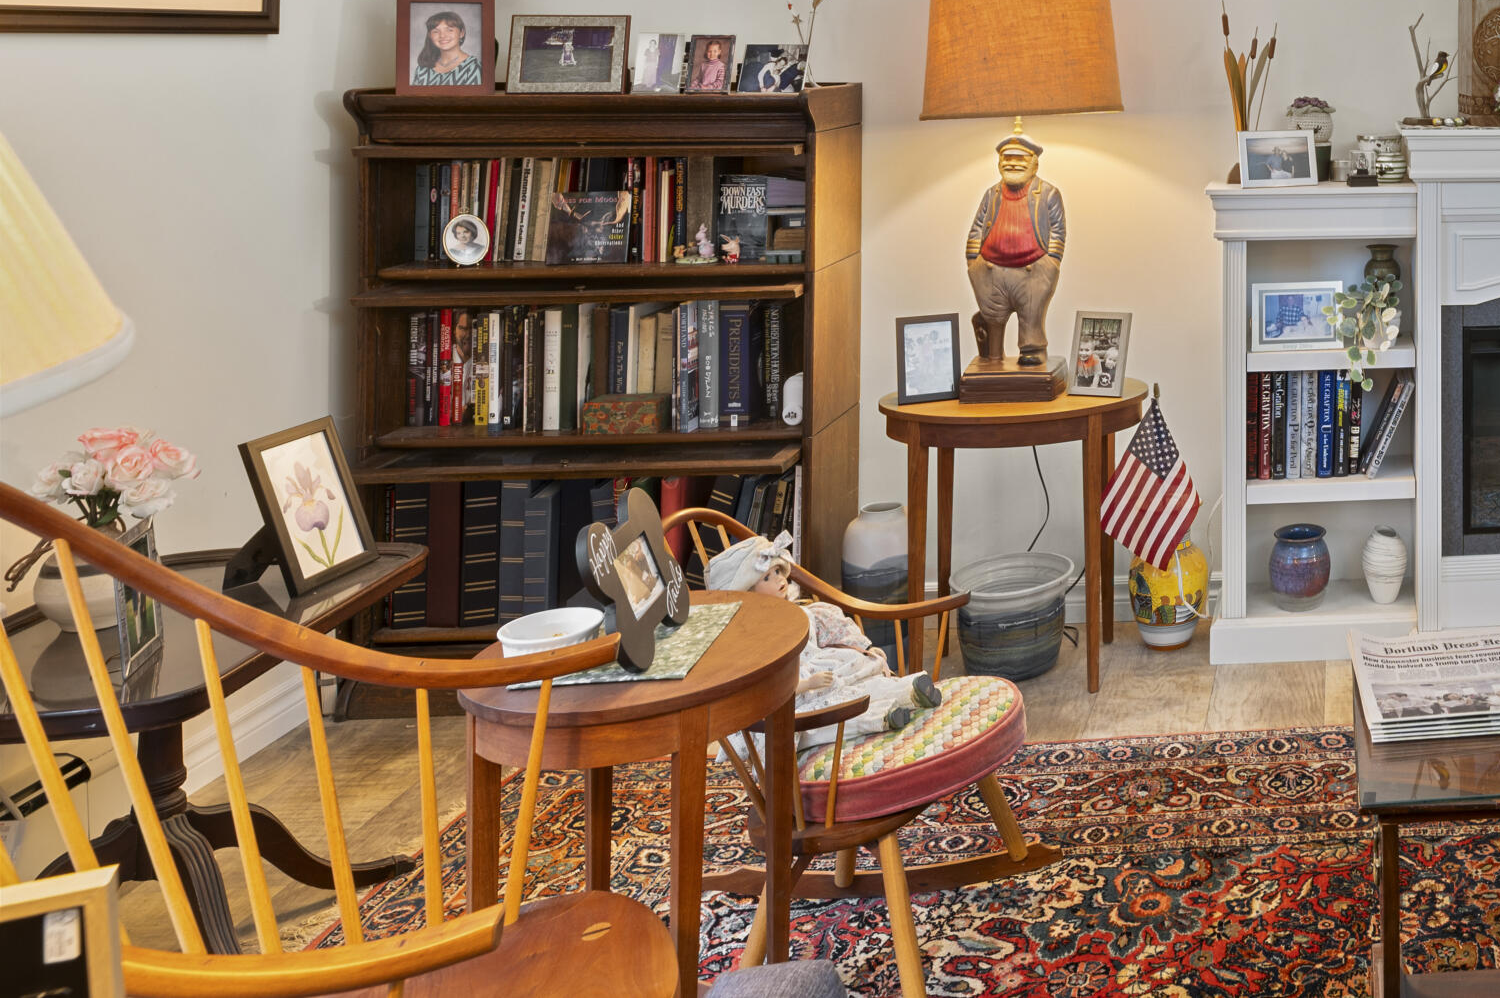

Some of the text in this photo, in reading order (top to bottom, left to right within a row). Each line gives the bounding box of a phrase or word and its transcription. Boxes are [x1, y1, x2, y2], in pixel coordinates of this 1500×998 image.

[521, 168, 531, 202] Hammer
[720, 186, 766, 197] DOWN EAST
[720, 196, 766, 214] MURDERS
[770, 308, 780, 383] NO DIRECTION HOME
[728, 318, 743, 400] PRESIDENTS
[454, 365, 462, 383] Idiot
[704, 355, 712, 398] BOB DYLAN
[1262, 373, 1271, 390] SUE
[1323, 374, 1331, 389] SUE
[1274, 374, 1285, 419] Sue Grafton
[1323, 389, 1331, 422] GRAFTON
[1261, 390, 1270, 430] GRAFTON
[1289, 423, 1299, 432] P
[1320, 423, 1331, 434] U
[1351, 426, 1360, 434] ED
[1290, 440, 1298, 451] for
[1289, 451, 1298, 469] Peril
[589, 526, 618, 586] Happy
[666, 560, 683, 618] Tails
[1384, 643, 1439, 655] Portland
[1443, 641, 1479, 651] Press
[1362, 655, 1379, 663] New
[1364, 661, 1385, 669] could
